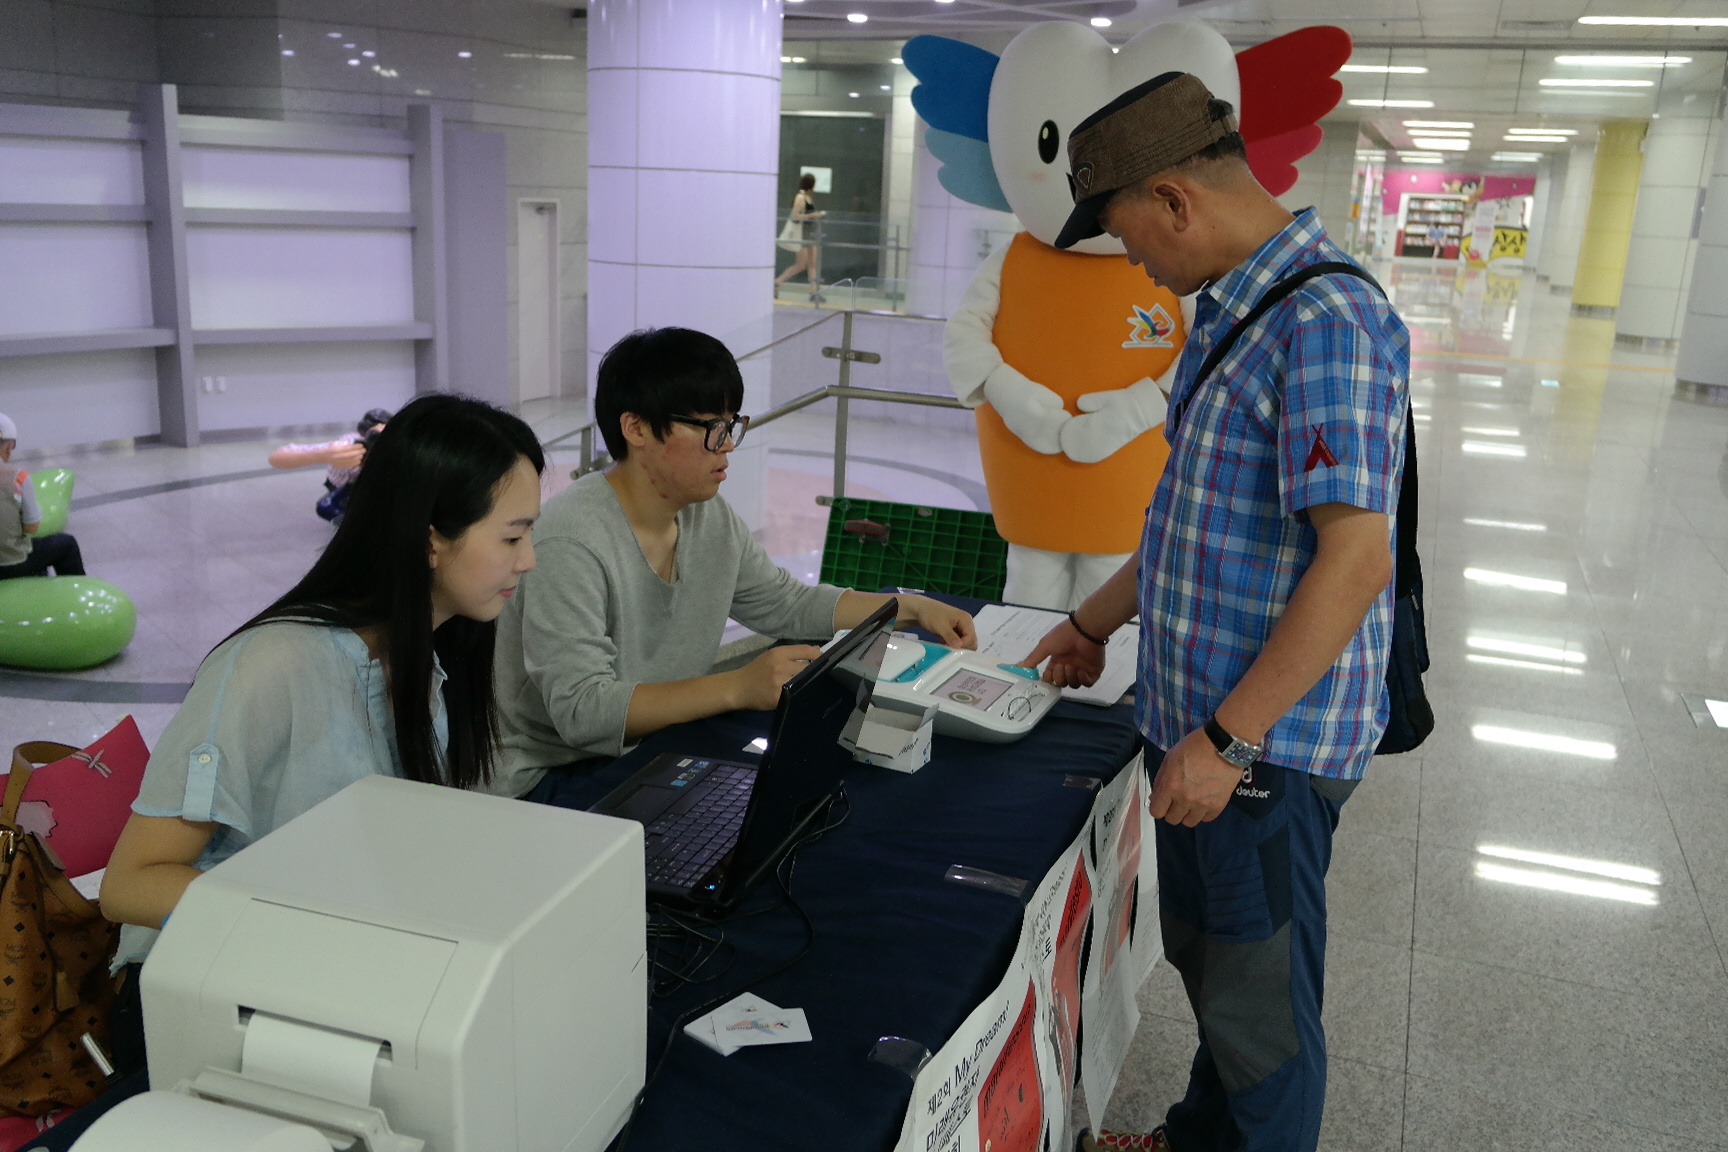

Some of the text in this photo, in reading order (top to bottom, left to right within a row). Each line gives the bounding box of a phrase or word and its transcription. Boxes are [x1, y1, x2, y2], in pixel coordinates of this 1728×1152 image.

[927, 1076, 951, 1116] 제2회
[954, 1055, 972, 1088] My
[973, 1000, 1010, 1063] Dream!
